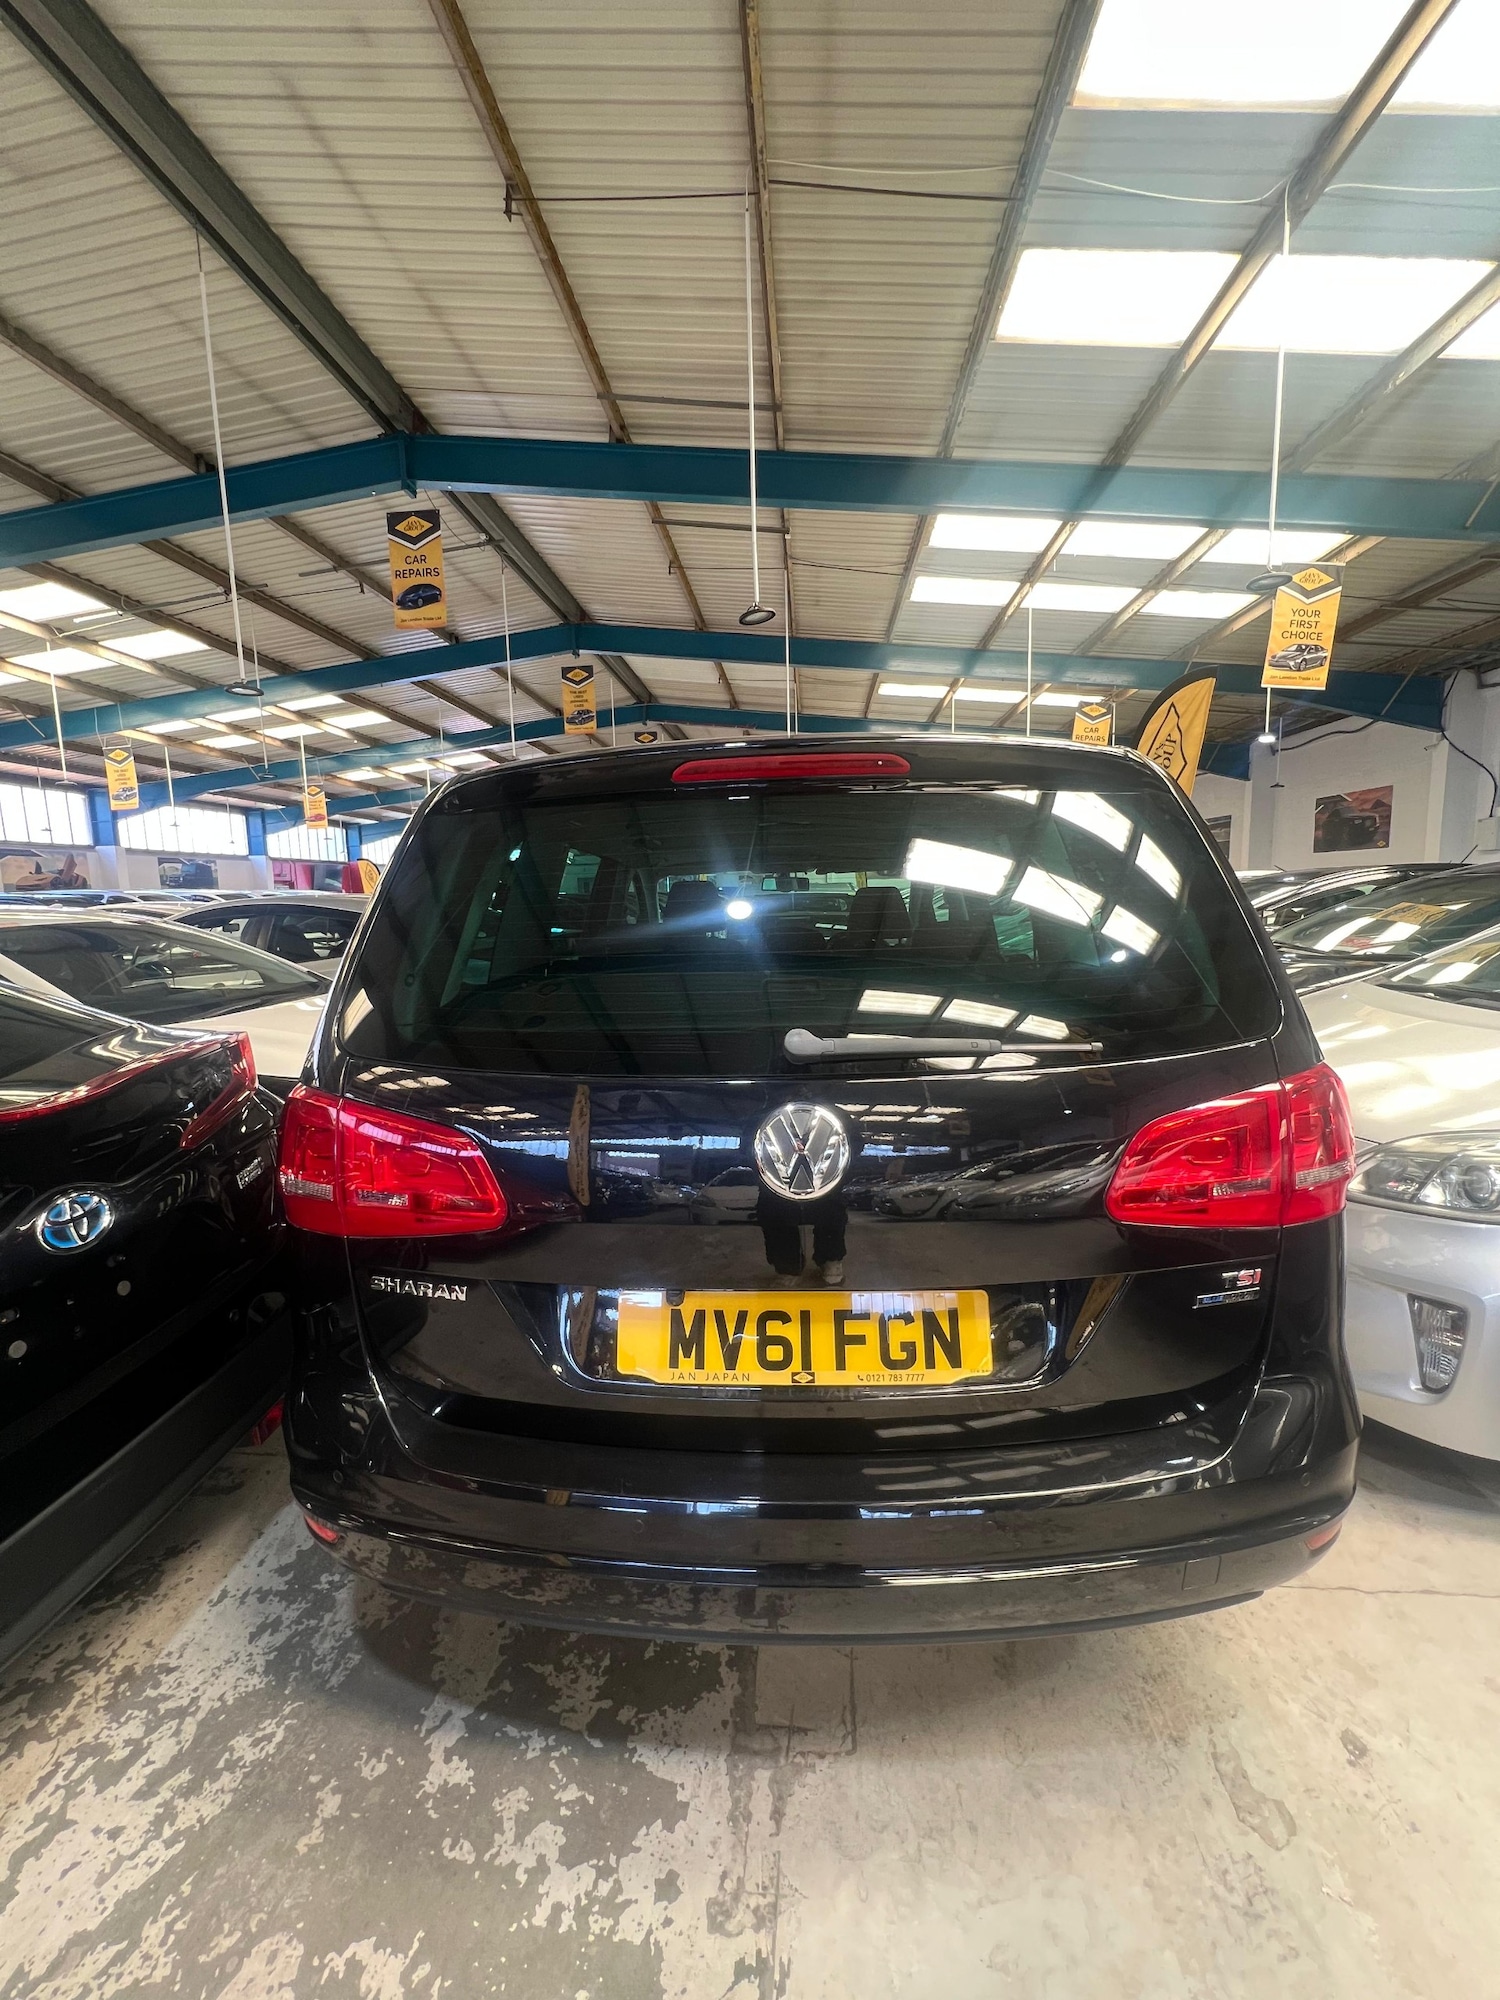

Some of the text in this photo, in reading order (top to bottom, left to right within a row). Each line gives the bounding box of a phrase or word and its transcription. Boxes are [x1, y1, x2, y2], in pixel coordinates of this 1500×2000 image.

[404, 554, 428, 565] CAR
[394, 568, 440, 580] REPAIRS
[1291, 608, 1321, 618] YOUR
[1290, 620, 1320, 630] FIRST
[1281, 630, 1324, 642] CHOICE
[1222, 1268, 1262, 1288] TSI
[370, 1276, 468, 1302] SHARAN
[668, 1308, 962, 1372] MV61 FGN
[671, 1372, 750, 1382] JAN JAPAN
[866, 1374, 925, 1382] 0121 783 7777
